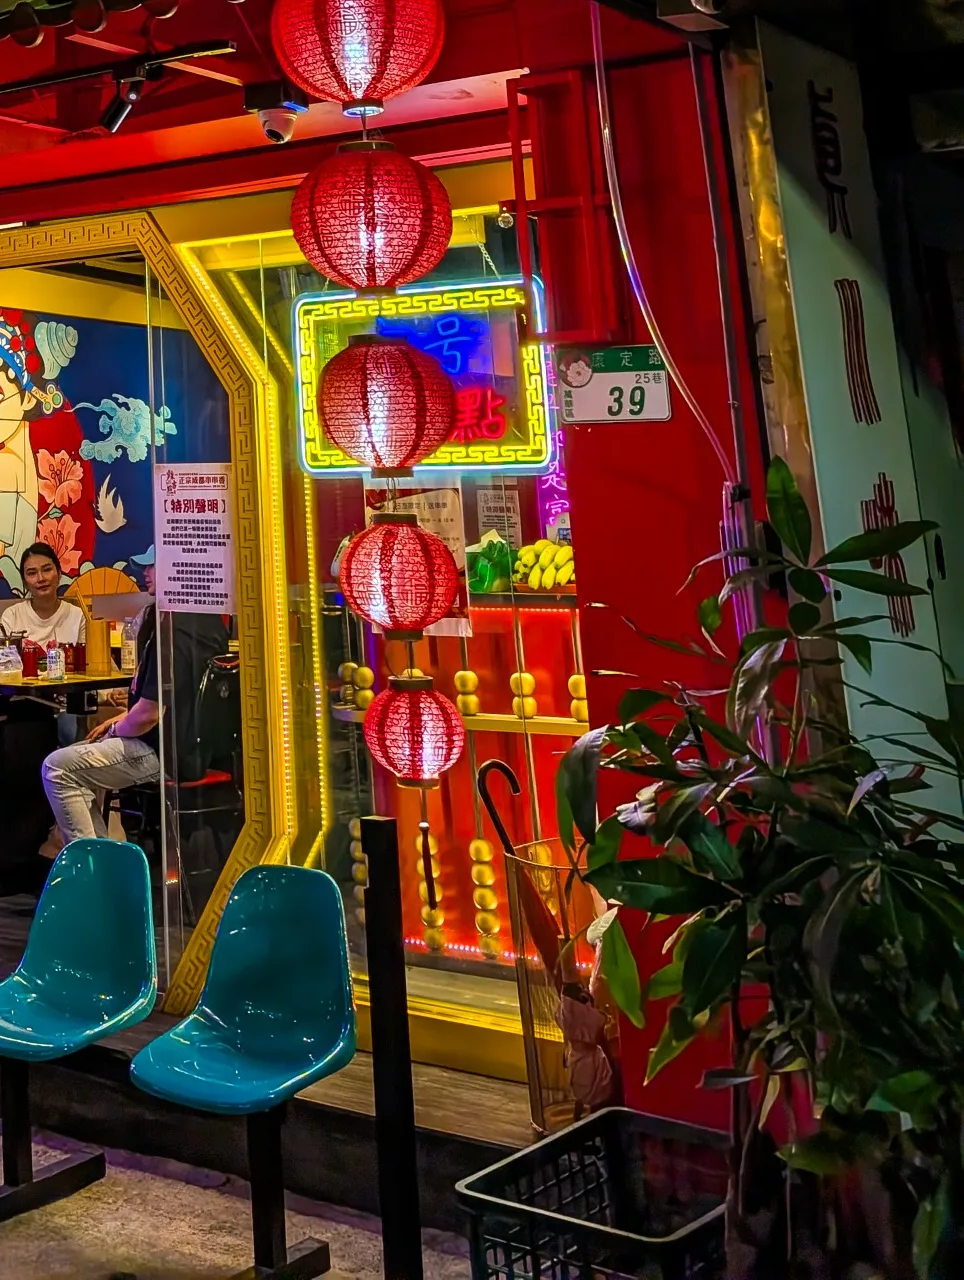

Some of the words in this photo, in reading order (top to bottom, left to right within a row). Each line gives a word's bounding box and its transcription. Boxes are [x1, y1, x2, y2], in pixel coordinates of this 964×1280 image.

[592, 349, 661, 368] 康定路
[635, 373, 662, 384] 25巷
[607, 386, 646, 416] 39
